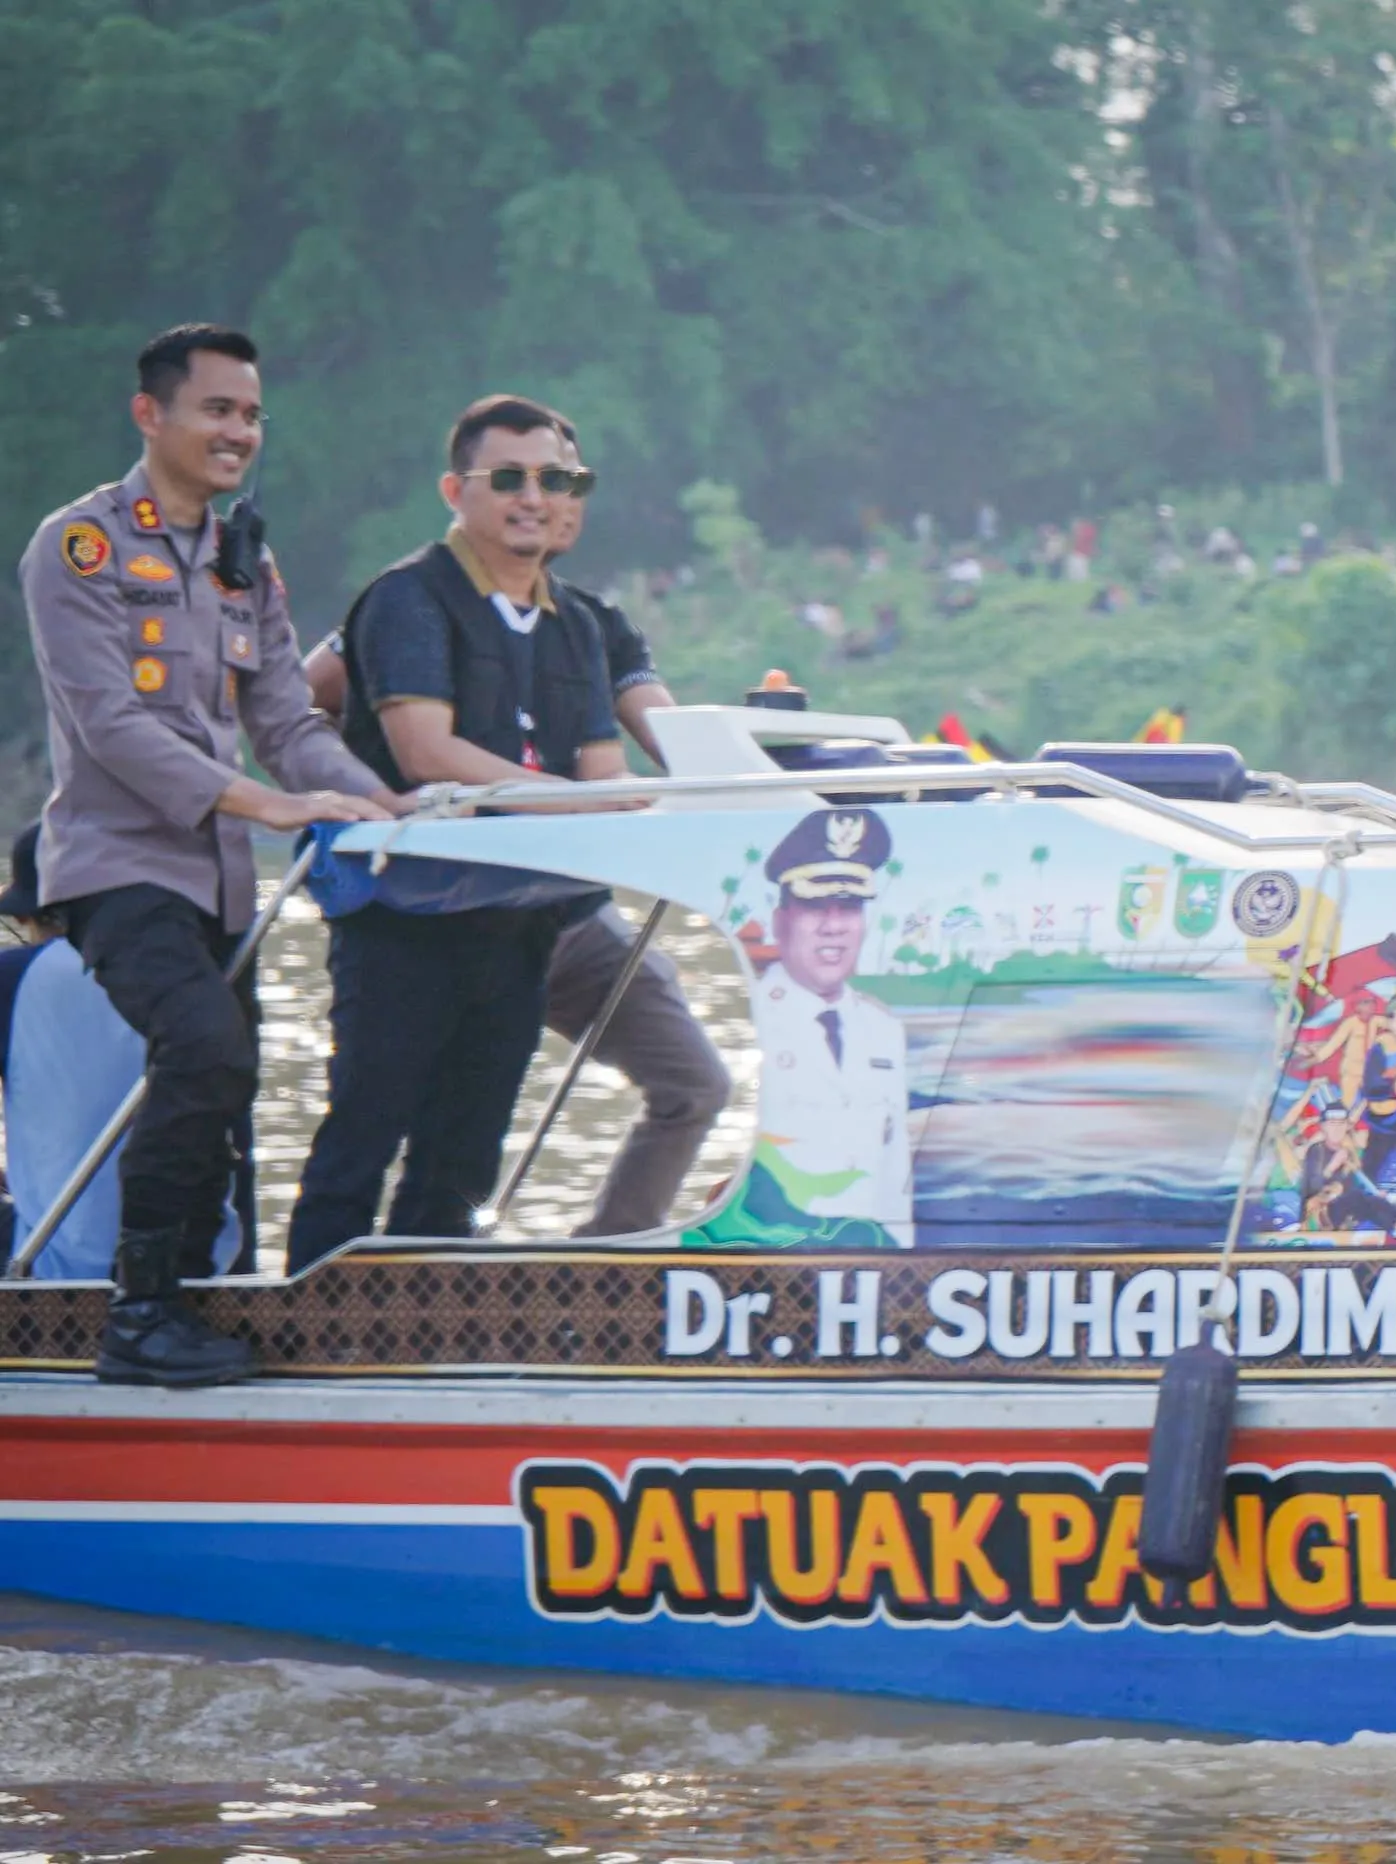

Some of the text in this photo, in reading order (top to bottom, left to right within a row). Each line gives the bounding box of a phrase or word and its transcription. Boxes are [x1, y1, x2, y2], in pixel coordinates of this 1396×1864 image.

[664, 1268, 794, 1358] Dr.
[816, 1269, 901, 1358] H.
[532, 1484, 1008, 1609] DATUAK
